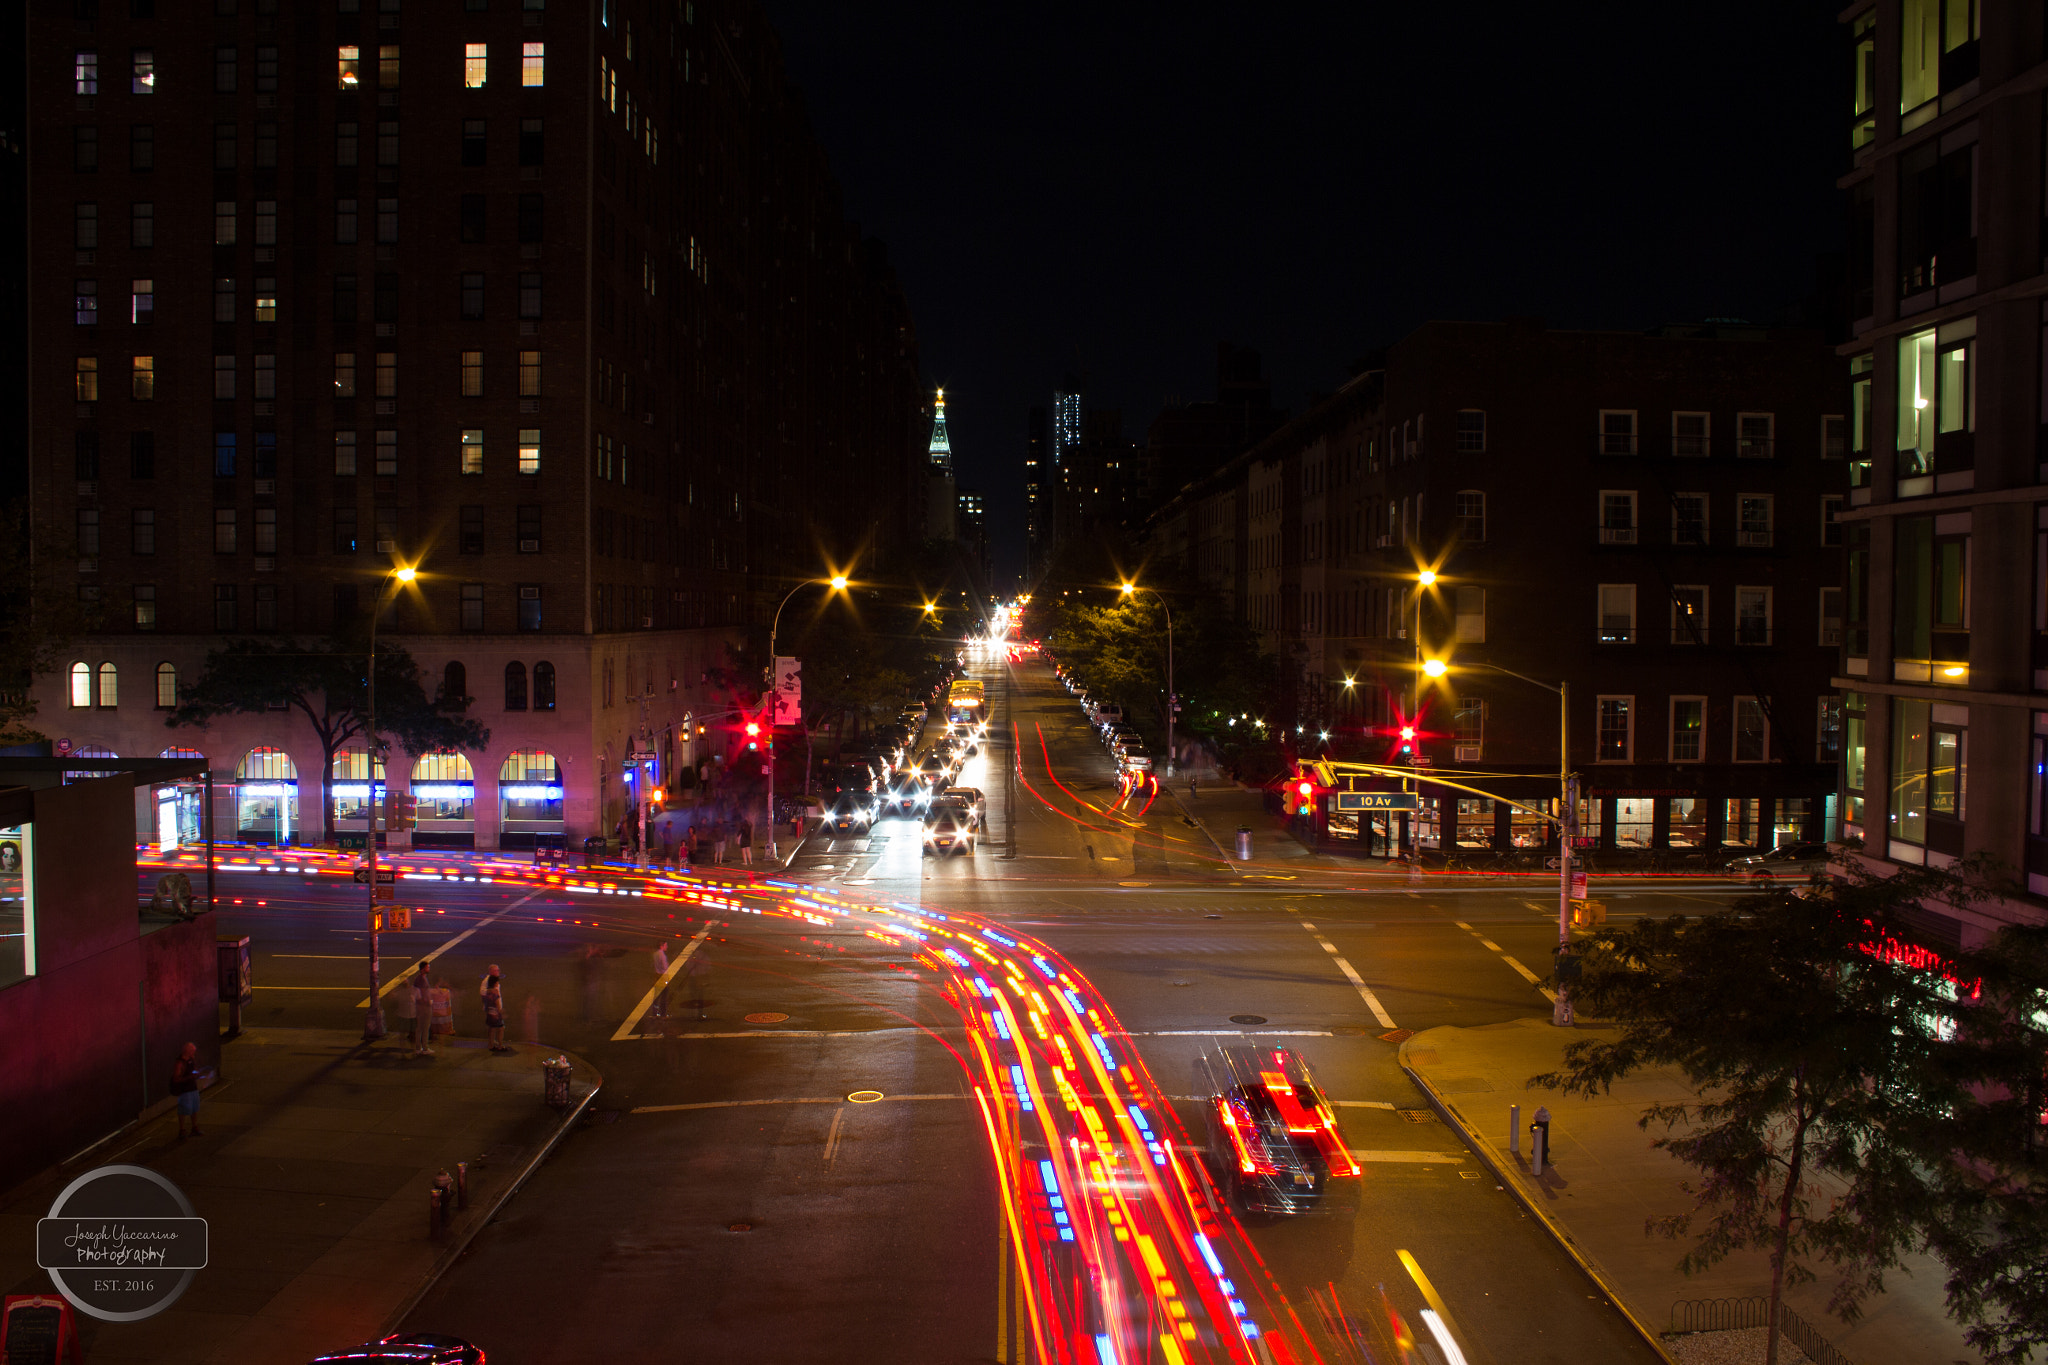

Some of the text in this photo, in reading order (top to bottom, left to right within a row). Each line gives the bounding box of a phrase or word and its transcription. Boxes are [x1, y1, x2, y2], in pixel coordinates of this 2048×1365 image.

[1361, 796, 1392, 806] 10 Av
[343, 838, 353, 848] 10
